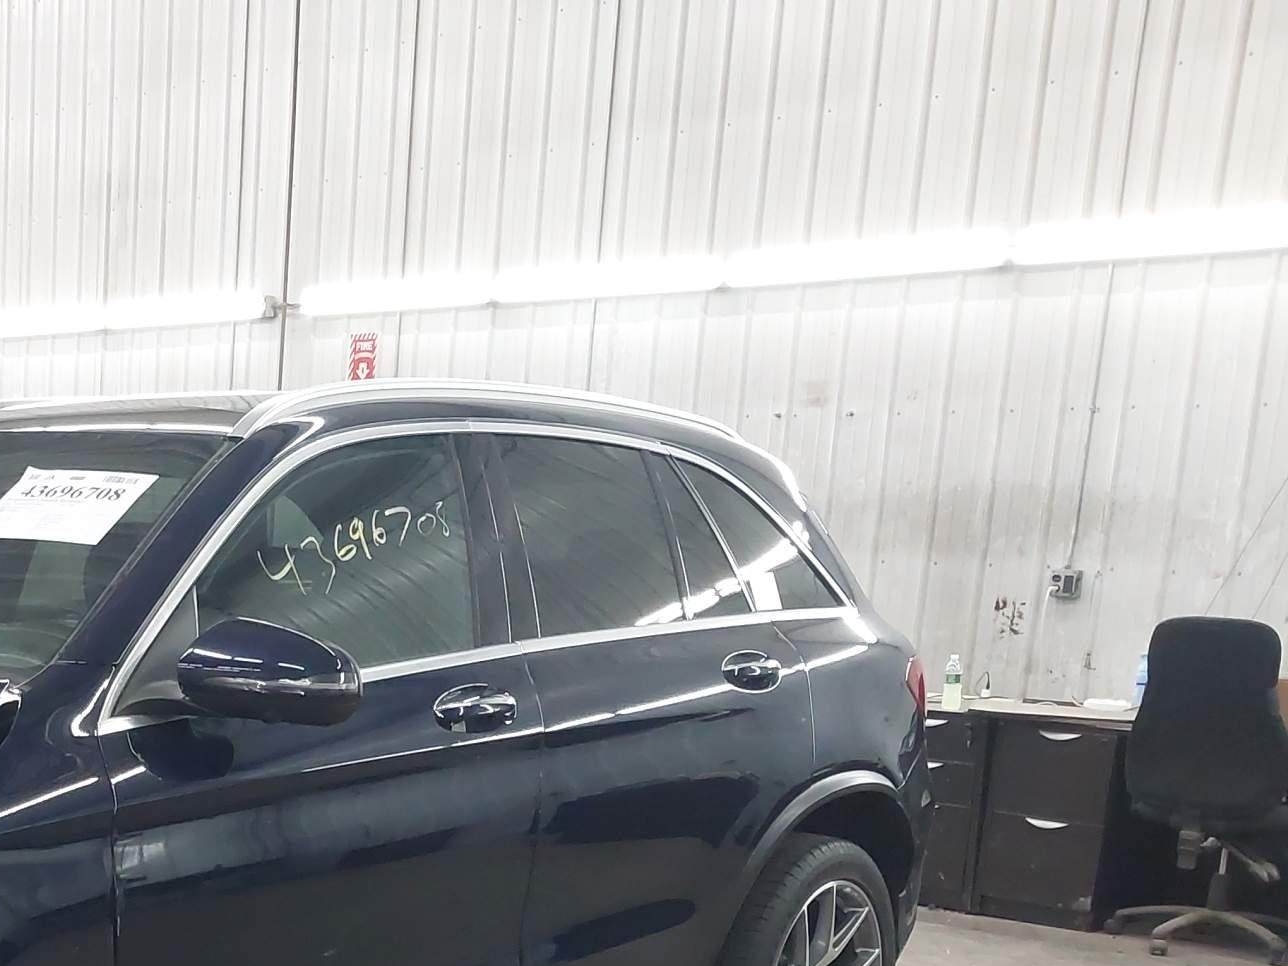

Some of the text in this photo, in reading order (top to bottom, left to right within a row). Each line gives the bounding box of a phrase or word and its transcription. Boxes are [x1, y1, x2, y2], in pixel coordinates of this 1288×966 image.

[355, 341, 373, 351] FIRE
[21, 485, 126, 501] 43696708
[257, 501, 450, 595] 43696708
